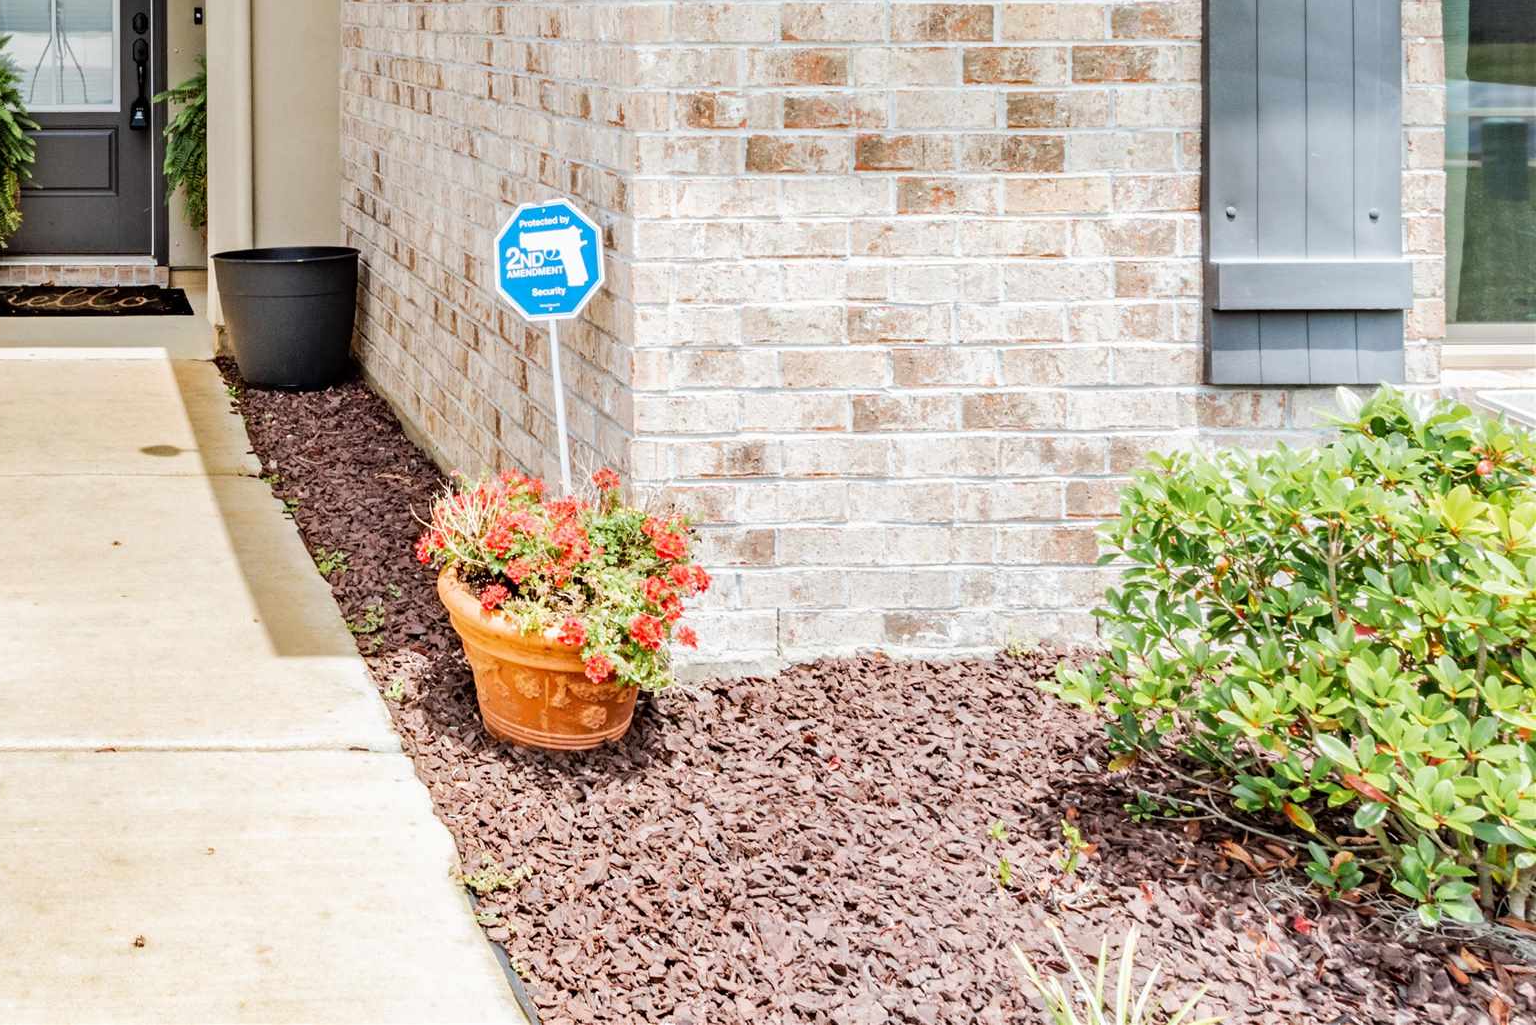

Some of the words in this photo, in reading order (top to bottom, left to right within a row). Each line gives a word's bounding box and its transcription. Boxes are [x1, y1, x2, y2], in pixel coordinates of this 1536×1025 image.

[519, 216, 558, 228] Protected
[559, 215, 570, 225] by
[505, 246, 545, 270] 2ND
[506, 265, 564, 279] AMENDMENT
[531, 286, 566, 297] Security
